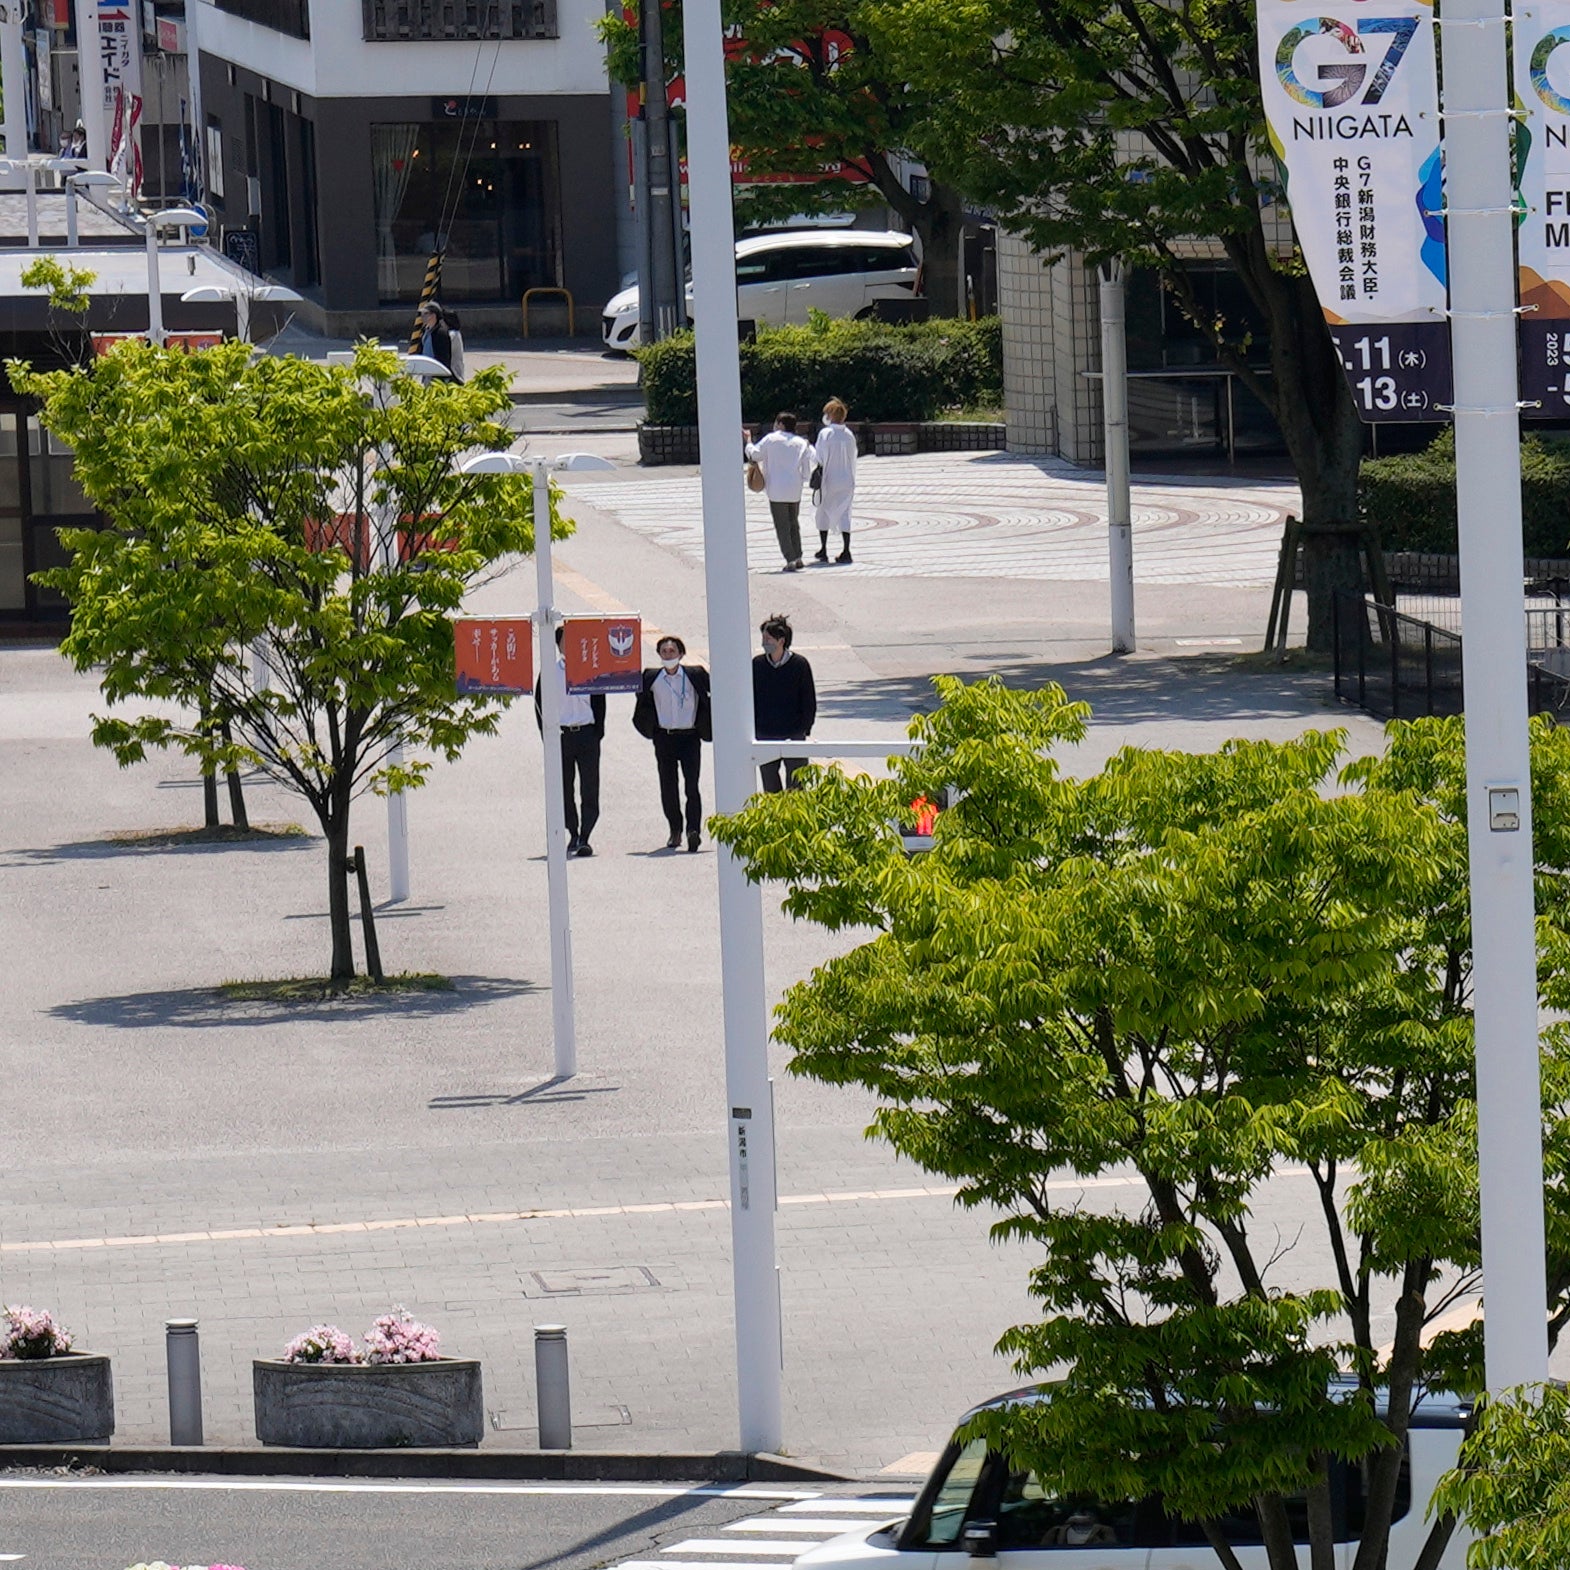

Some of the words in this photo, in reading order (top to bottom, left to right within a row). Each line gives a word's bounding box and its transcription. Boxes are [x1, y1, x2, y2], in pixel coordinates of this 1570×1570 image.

[101, 36, 120, 83] エイド
[1276, 16, 1421, 108] G7
[1294, 115, 1413, 140] NIIGATA
[1334, 157, 1356, 300] 中央銀行総裁会議
[1547, 333, 1558, 365] 2023
